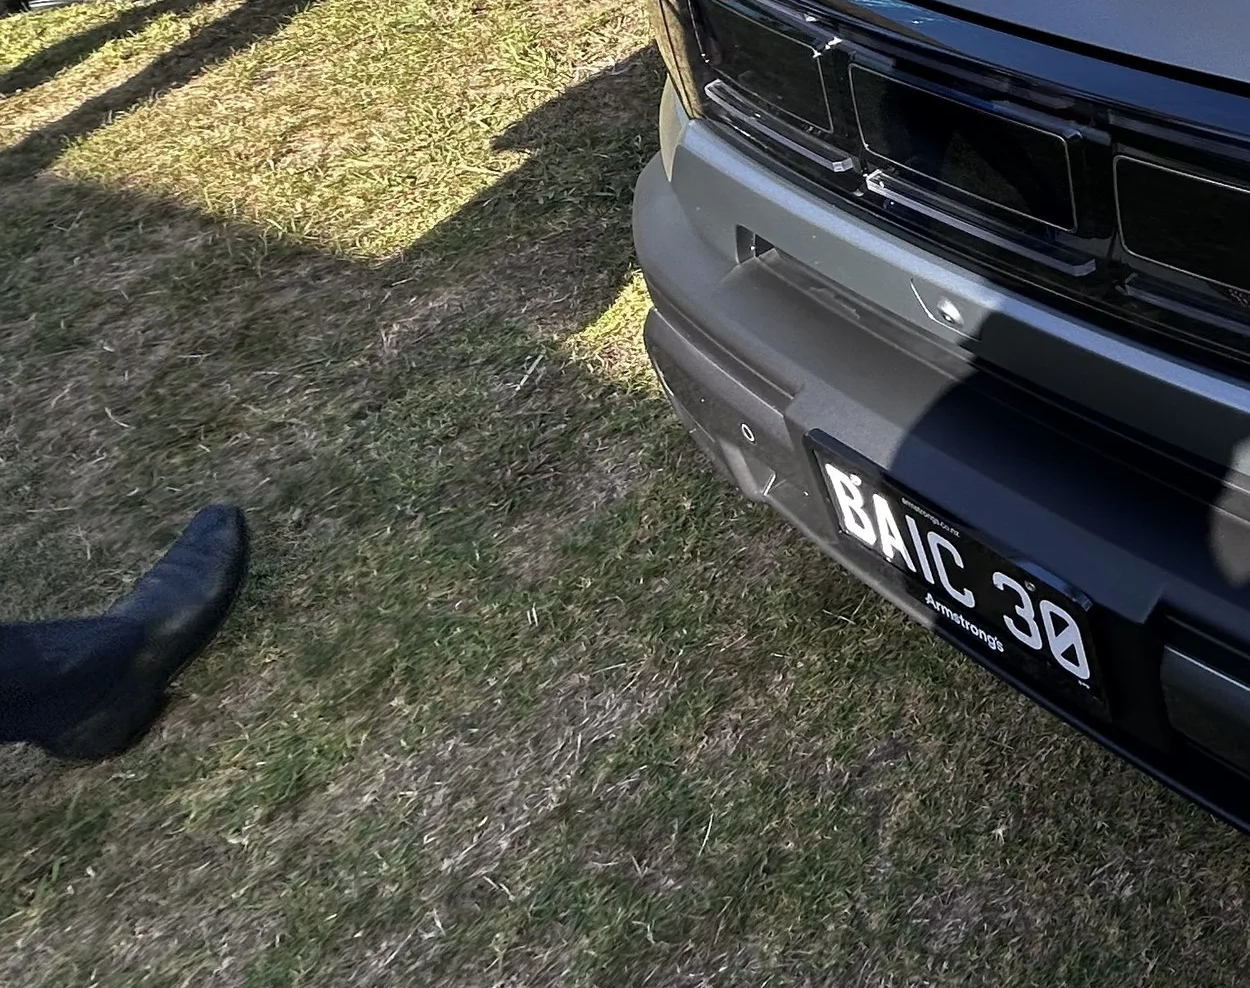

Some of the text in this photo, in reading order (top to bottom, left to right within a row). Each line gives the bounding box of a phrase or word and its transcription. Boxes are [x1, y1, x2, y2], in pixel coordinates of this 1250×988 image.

[825, 463, 1091, 680] BAIC 30
[924, 592, 1005, 653] Armstrong's
